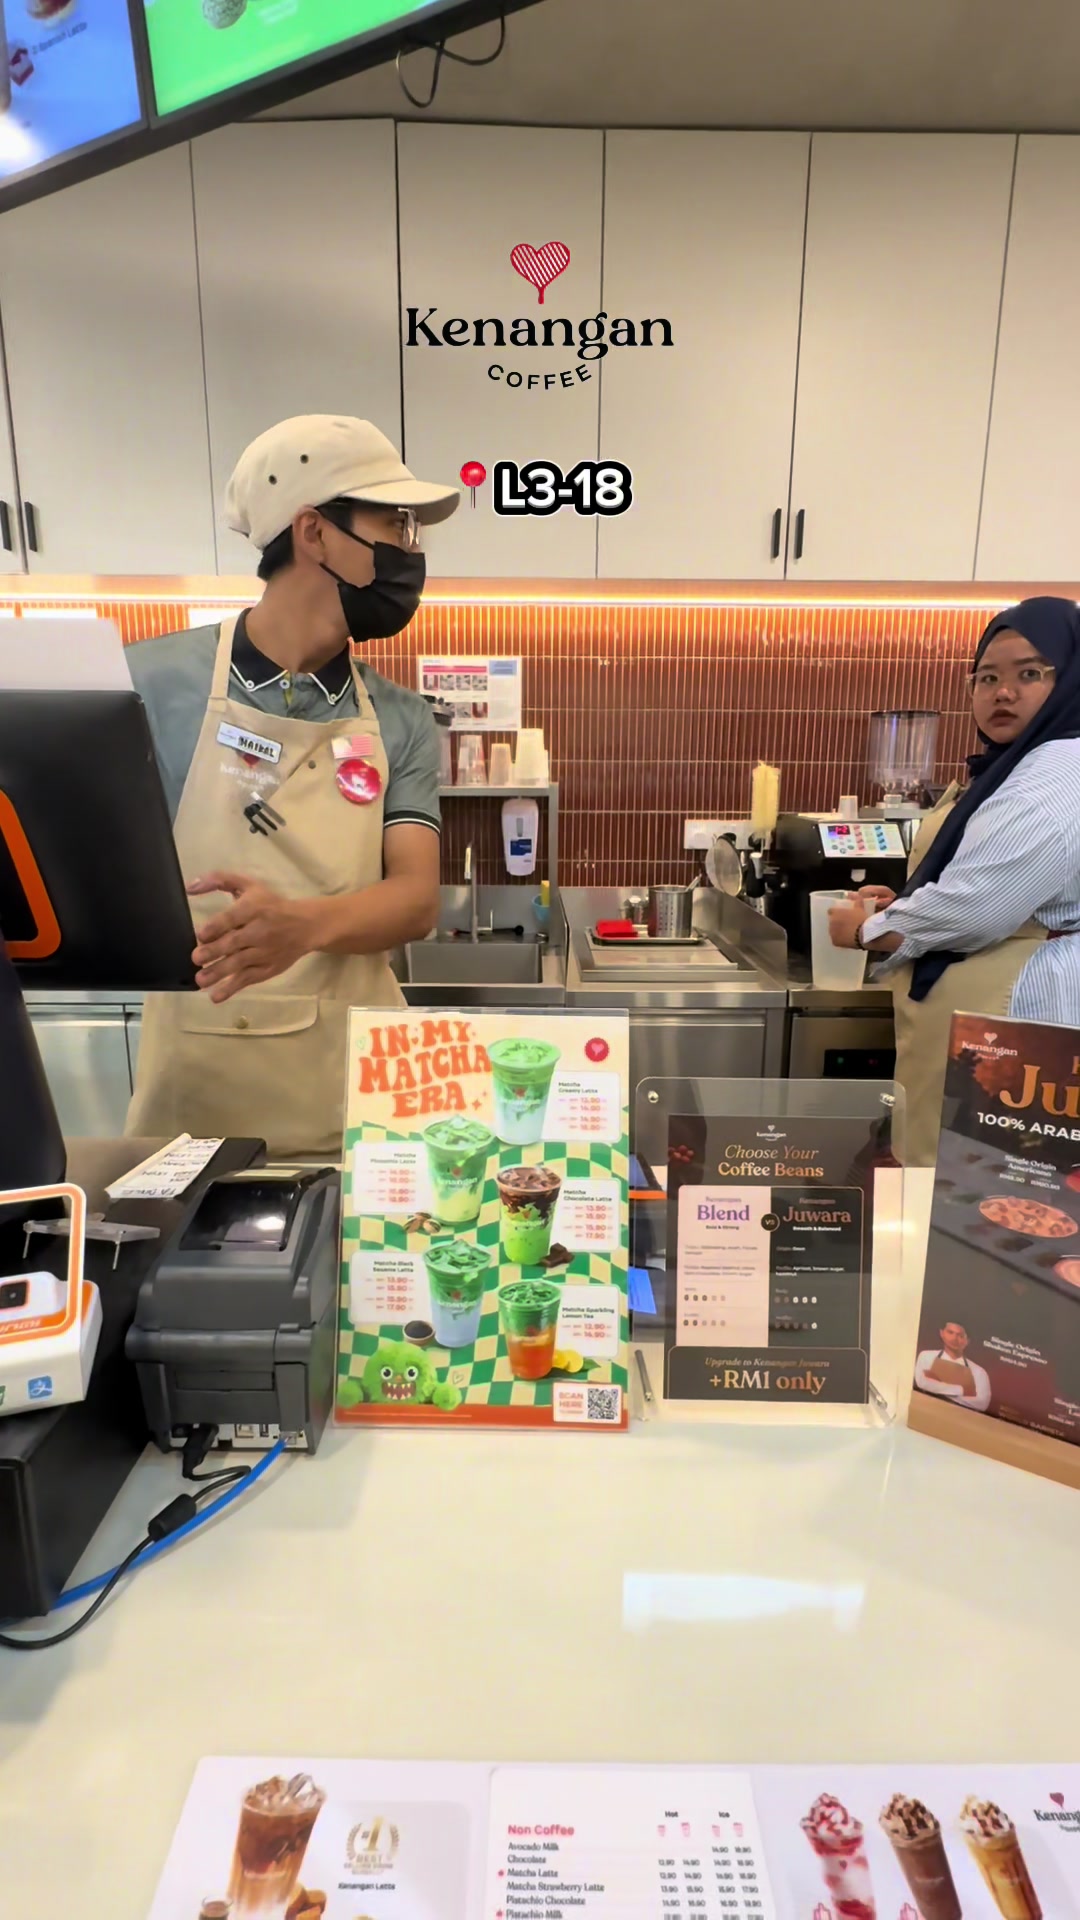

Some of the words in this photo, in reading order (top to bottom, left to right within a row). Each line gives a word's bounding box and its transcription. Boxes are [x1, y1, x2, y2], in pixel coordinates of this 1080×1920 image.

[421, 1020, 472, 1048] MY
[961, 1040, 1018, 1057] Kenangan
[358, 1045, 493, 1093] MATCHA
[392, 1081, 467, 1118] ERA
[977, 1112, 1025, 1131] 100%
[725, 1145, 778, 1159] Choose
[783, 1145, 819, 1159] Your
[718, 1162, 770, 1177] Coffee
[775, 1163, 824, 1177] Beans
[1004, 1155, 1029, 1165] Single
[1030, 1160, 1057, 1171] Origin
[1008, 1163, 1052, 1177] Americano
[697, 1205, 750, 1221] Blend
[783, 1206, 852, 1223] Juwara
[1012, 1349, 1048, 1364] Espresso
[1015, 1344, 1041, 1356] Origin
[705, 1357, 741, 1367] Upgrade
[709, 1369, 770, 1389] +RM1
[775, 1371, 827, 1395] only
[508, 1825, 531, 1835] Non
[534, 1824, 575, 1836] Coffee
[508, 1842, 541, 1851] Avocado
[542, 1843, 559, 1851] Milk
[507, 1855, 546, 1864] Chocolate
[507, 1868, 537, 1877] Matcha
[538, 1869, 558, 1878] Latte
[338, 1883, 374, 1891] Kenangan
[506, 1882, 536, 1891] Matcha
[538, 1882, 582, 1894] Strawberry
[584, 1882, 605, 1892] Latte
[506, 1894, 544, 1905] Pistachio
[545, 1895, 586, 1906] Chocolate
[506, 1908, 544, 1920] Pistachio
[546, 1910, 563, 1920] Milk
